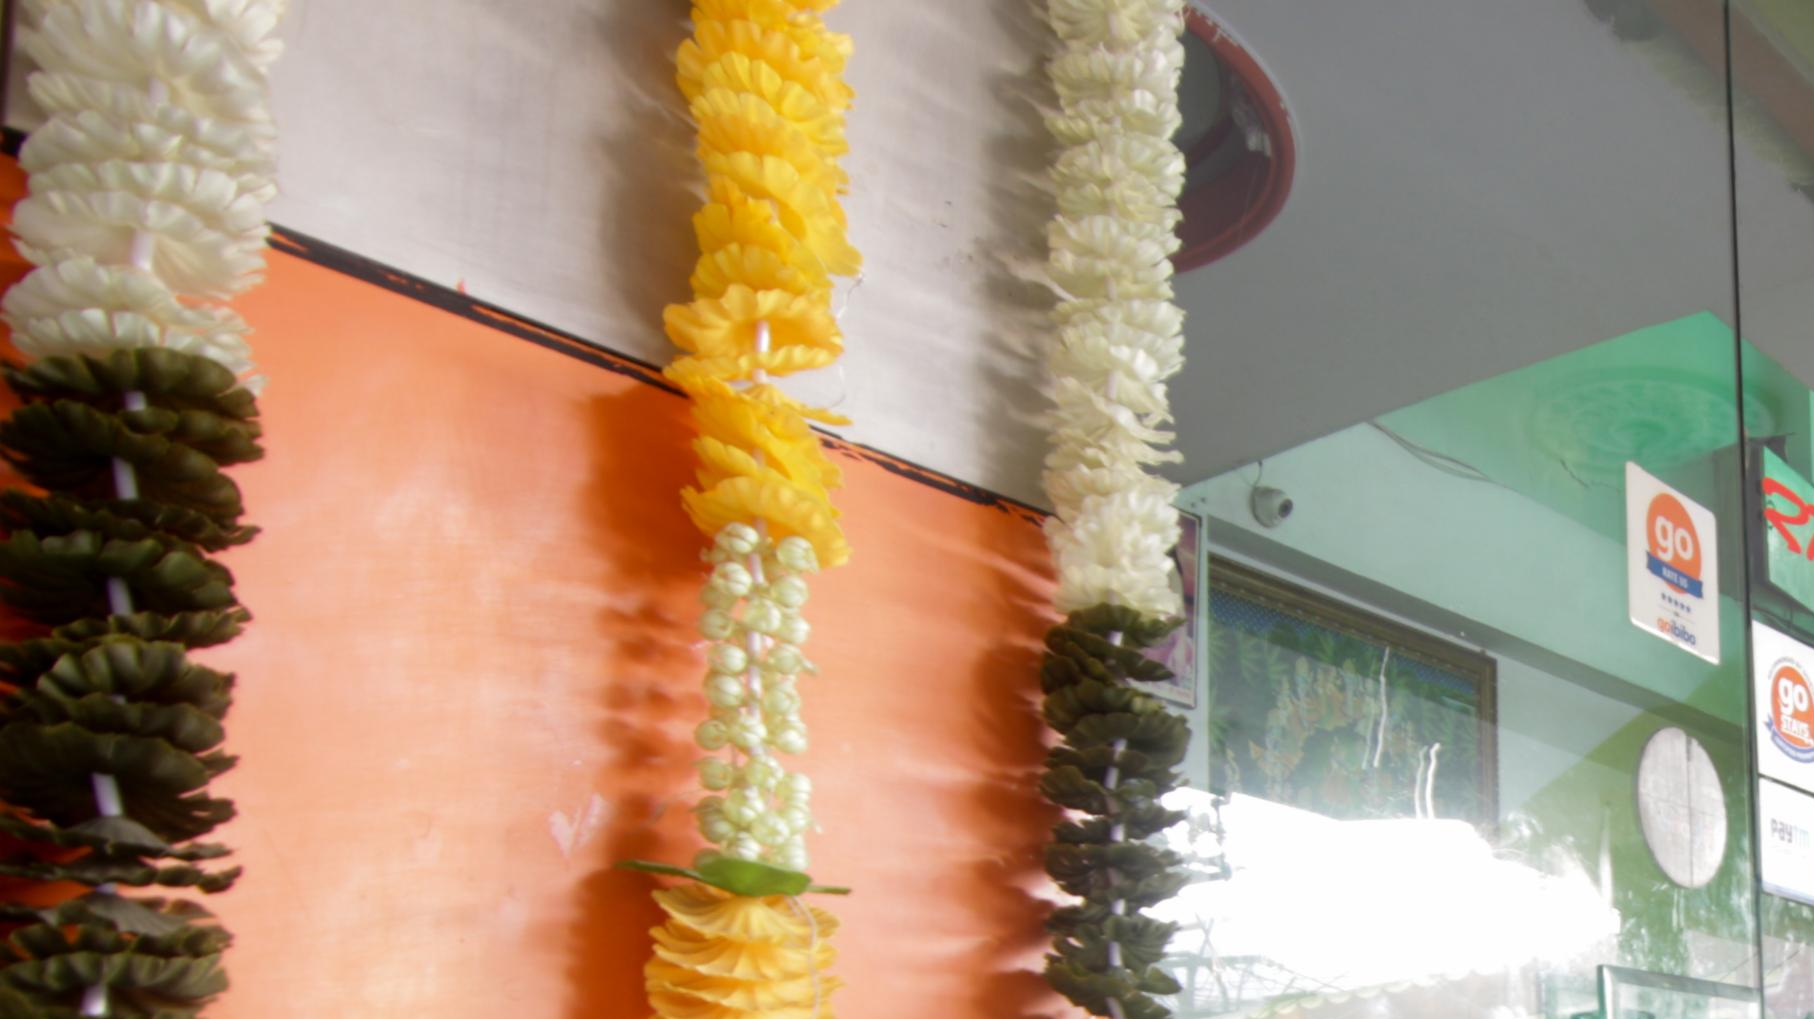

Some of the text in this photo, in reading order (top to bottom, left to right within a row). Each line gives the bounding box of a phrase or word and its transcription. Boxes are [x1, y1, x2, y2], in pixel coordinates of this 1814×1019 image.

[1655, 515, 1693, 561] go
[1656, 616, 1697, 646] goibibo
[1778, 677, 1810, 716] go
